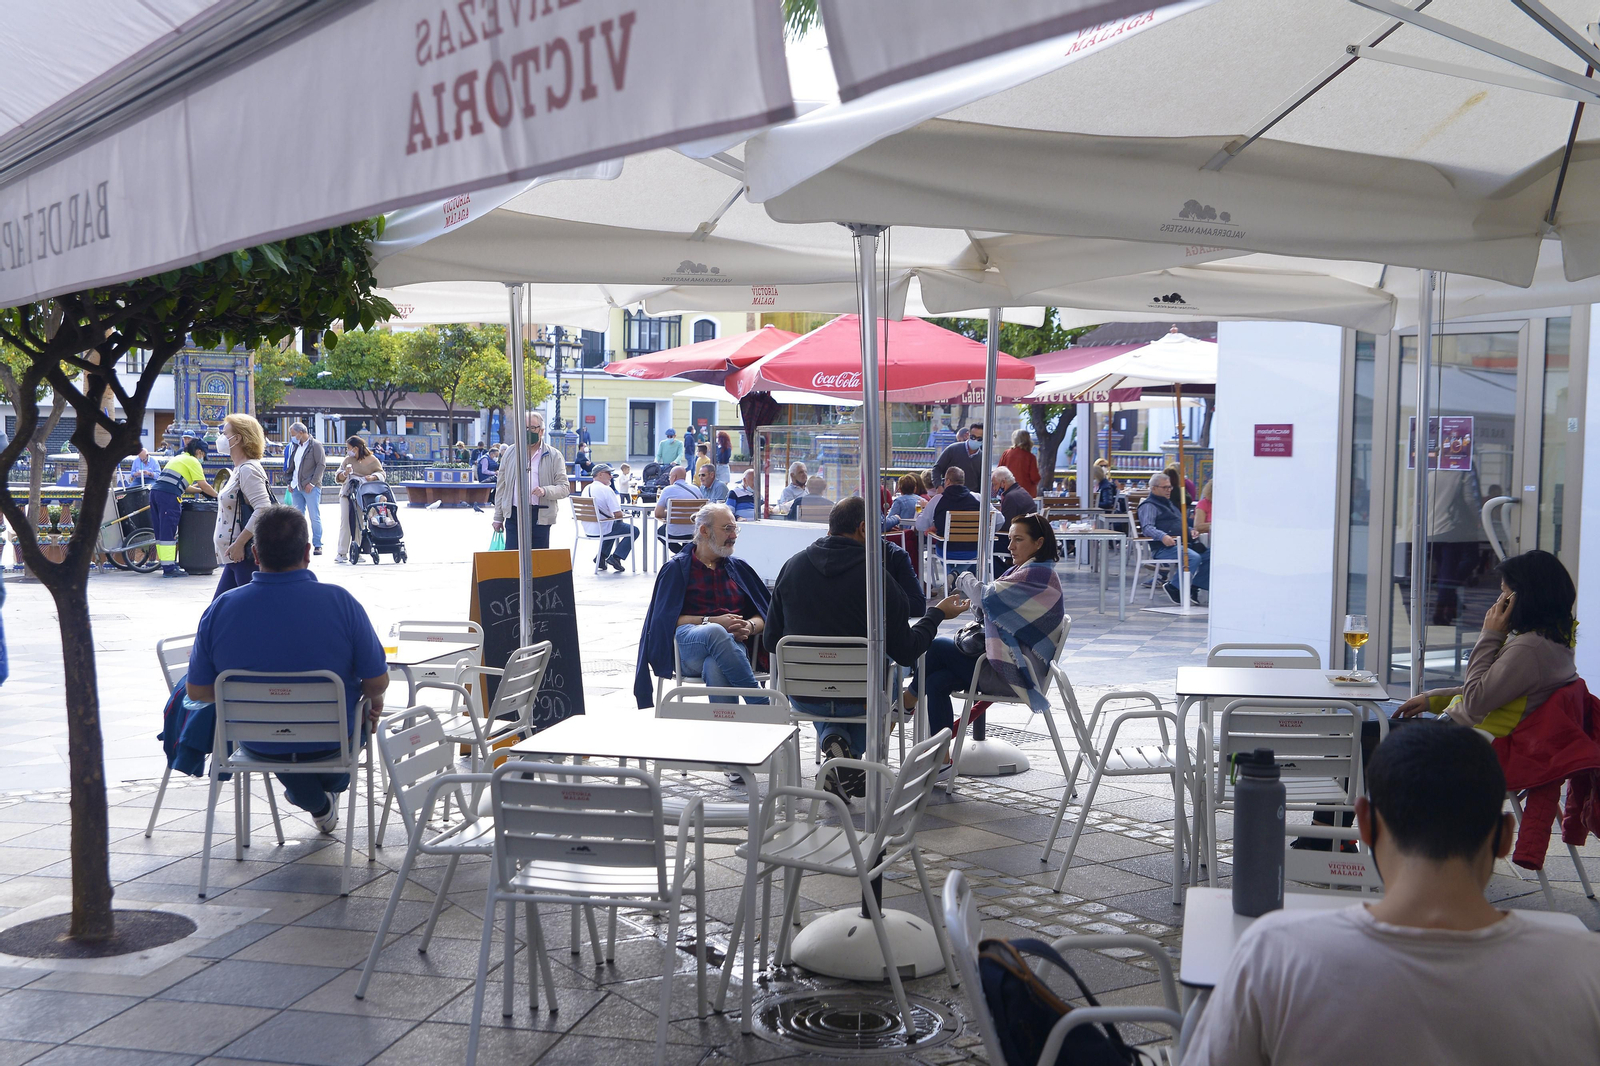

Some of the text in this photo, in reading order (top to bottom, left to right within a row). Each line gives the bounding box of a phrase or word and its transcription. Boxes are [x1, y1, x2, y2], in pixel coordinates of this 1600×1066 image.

[752, 287, 779, 296] VICTORIA
[812, 371, 863, 388] Coca-Cola
[1328, 863, 1366, 871] VICTORIA
